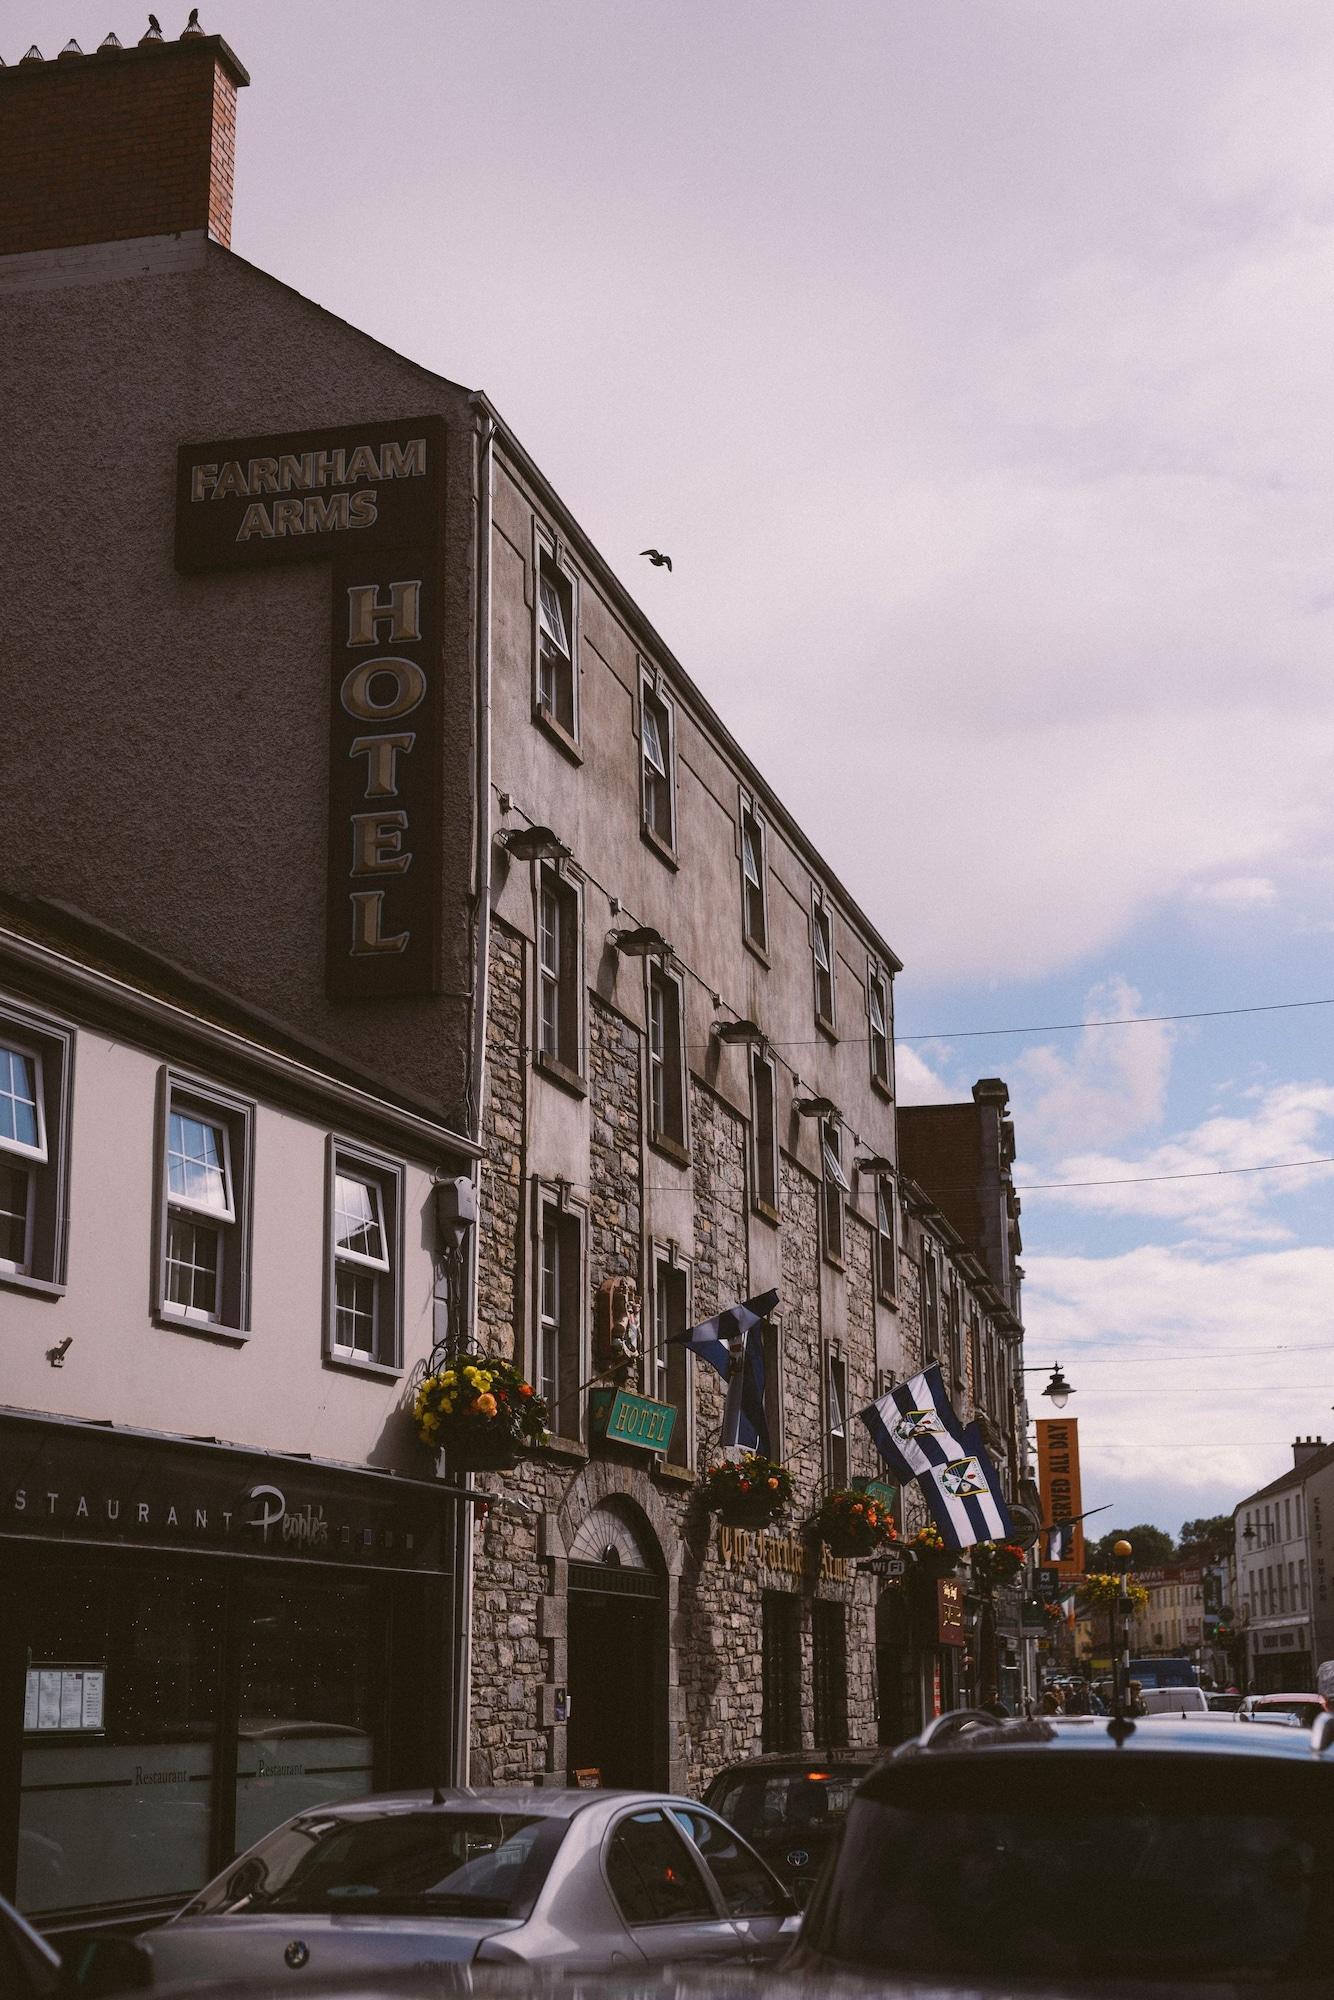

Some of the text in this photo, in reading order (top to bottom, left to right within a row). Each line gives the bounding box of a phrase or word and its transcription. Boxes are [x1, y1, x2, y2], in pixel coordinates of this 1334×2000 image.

[190, 438, 428, 502] FARNHAM
[235, 488, 378, 543] ARMS
[340, 579, 427, 957] HOTEL
[616, 1402, 667, 1442] HOTEL
[1047, 1423, 1069, 1450] DAY
[1048, 1453, 1070, 1475] ALL
[135, 1766, 188, 1786] Restaurant
[258, 1759, 304, 1778] Restaurant
